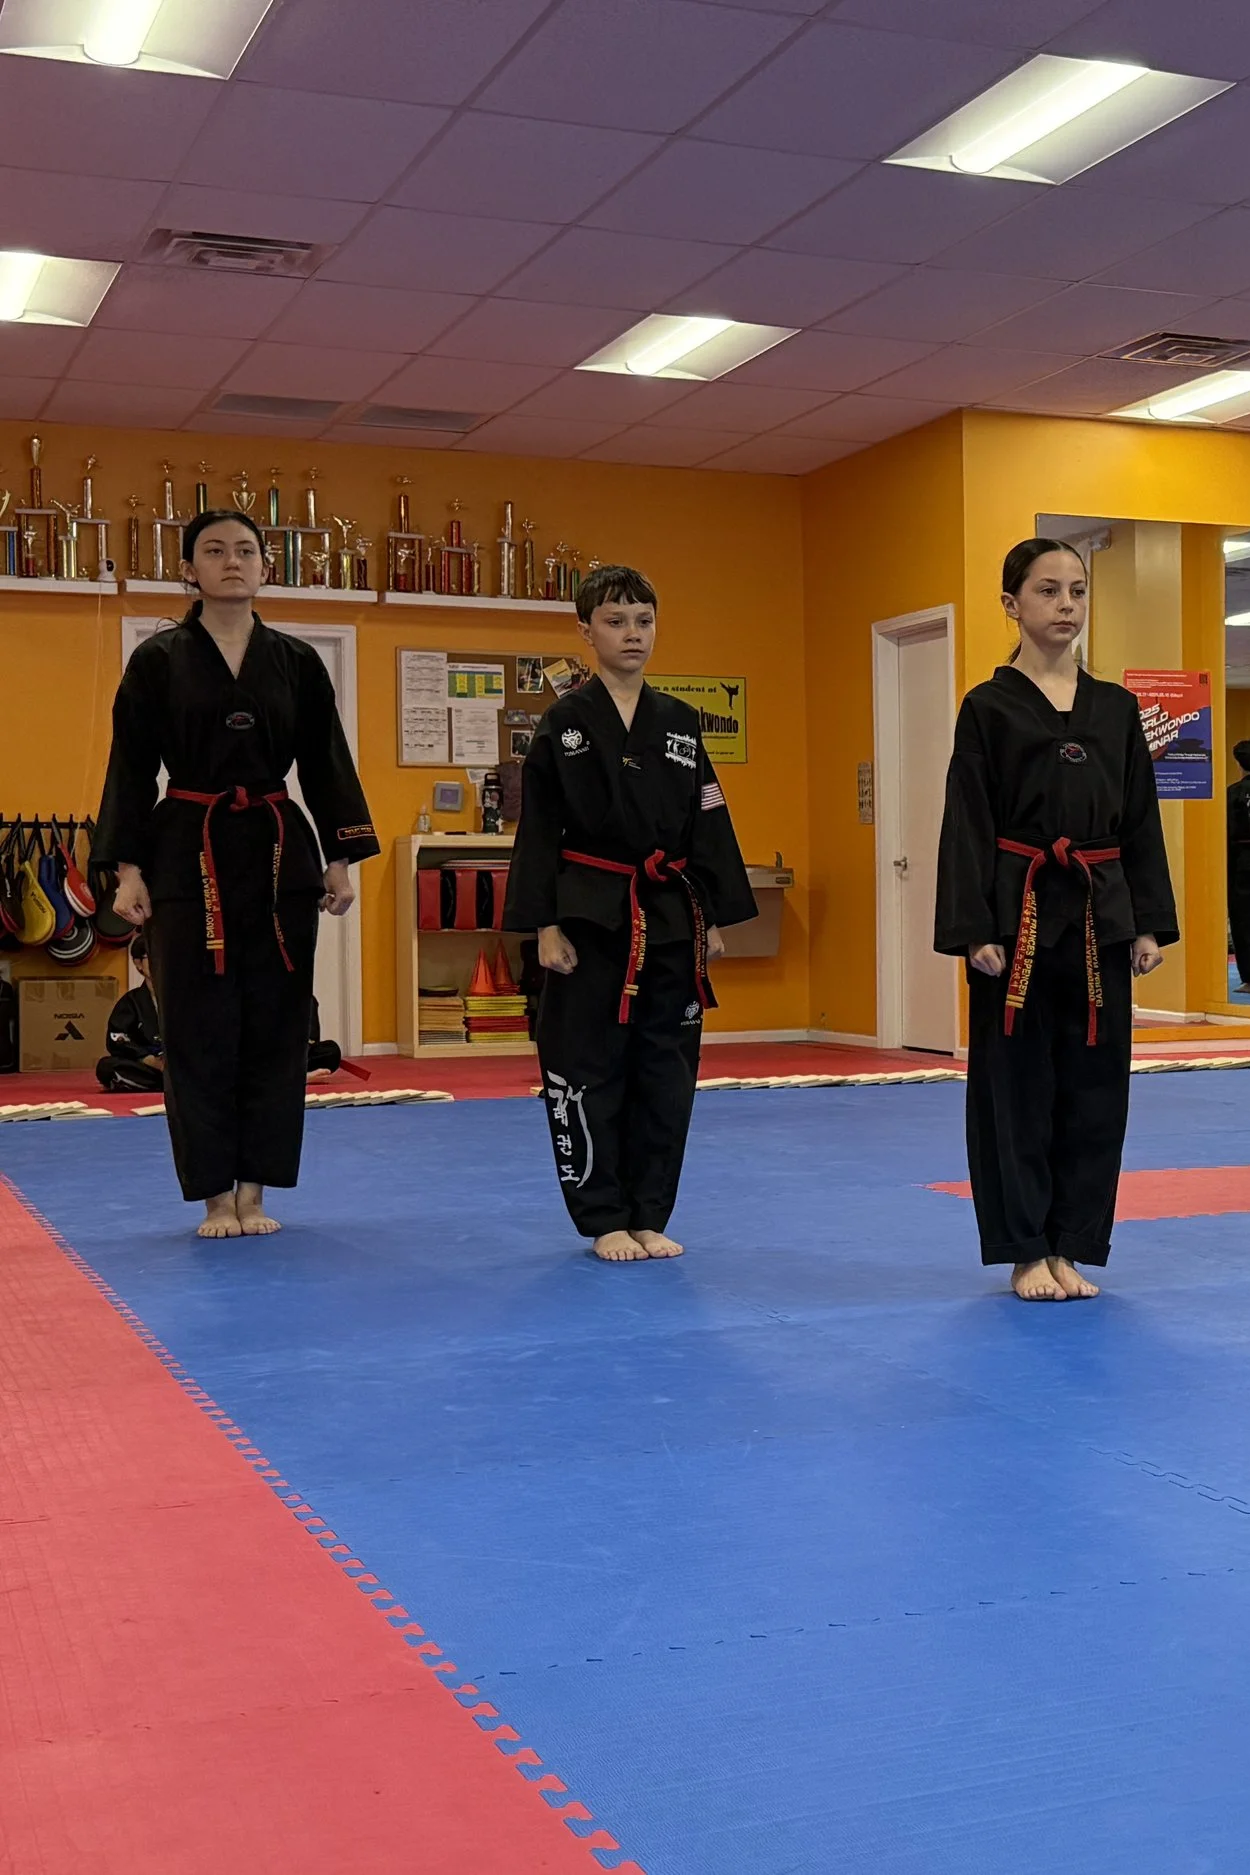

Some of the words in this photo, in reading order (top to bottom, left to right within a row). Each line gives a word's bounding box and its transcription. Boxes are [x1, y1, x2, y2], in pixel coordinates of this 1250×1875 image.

[671, 684, 705, 693] student
[700, 706, 739, 733] kwondo
[1139, 703, 1161, 720] 025
[1144, 711, 1200, 742] EKWONDO
[1026, 918, 1038, 956] FRANCES
[1018, 958, 1034, 996] SPENCER
